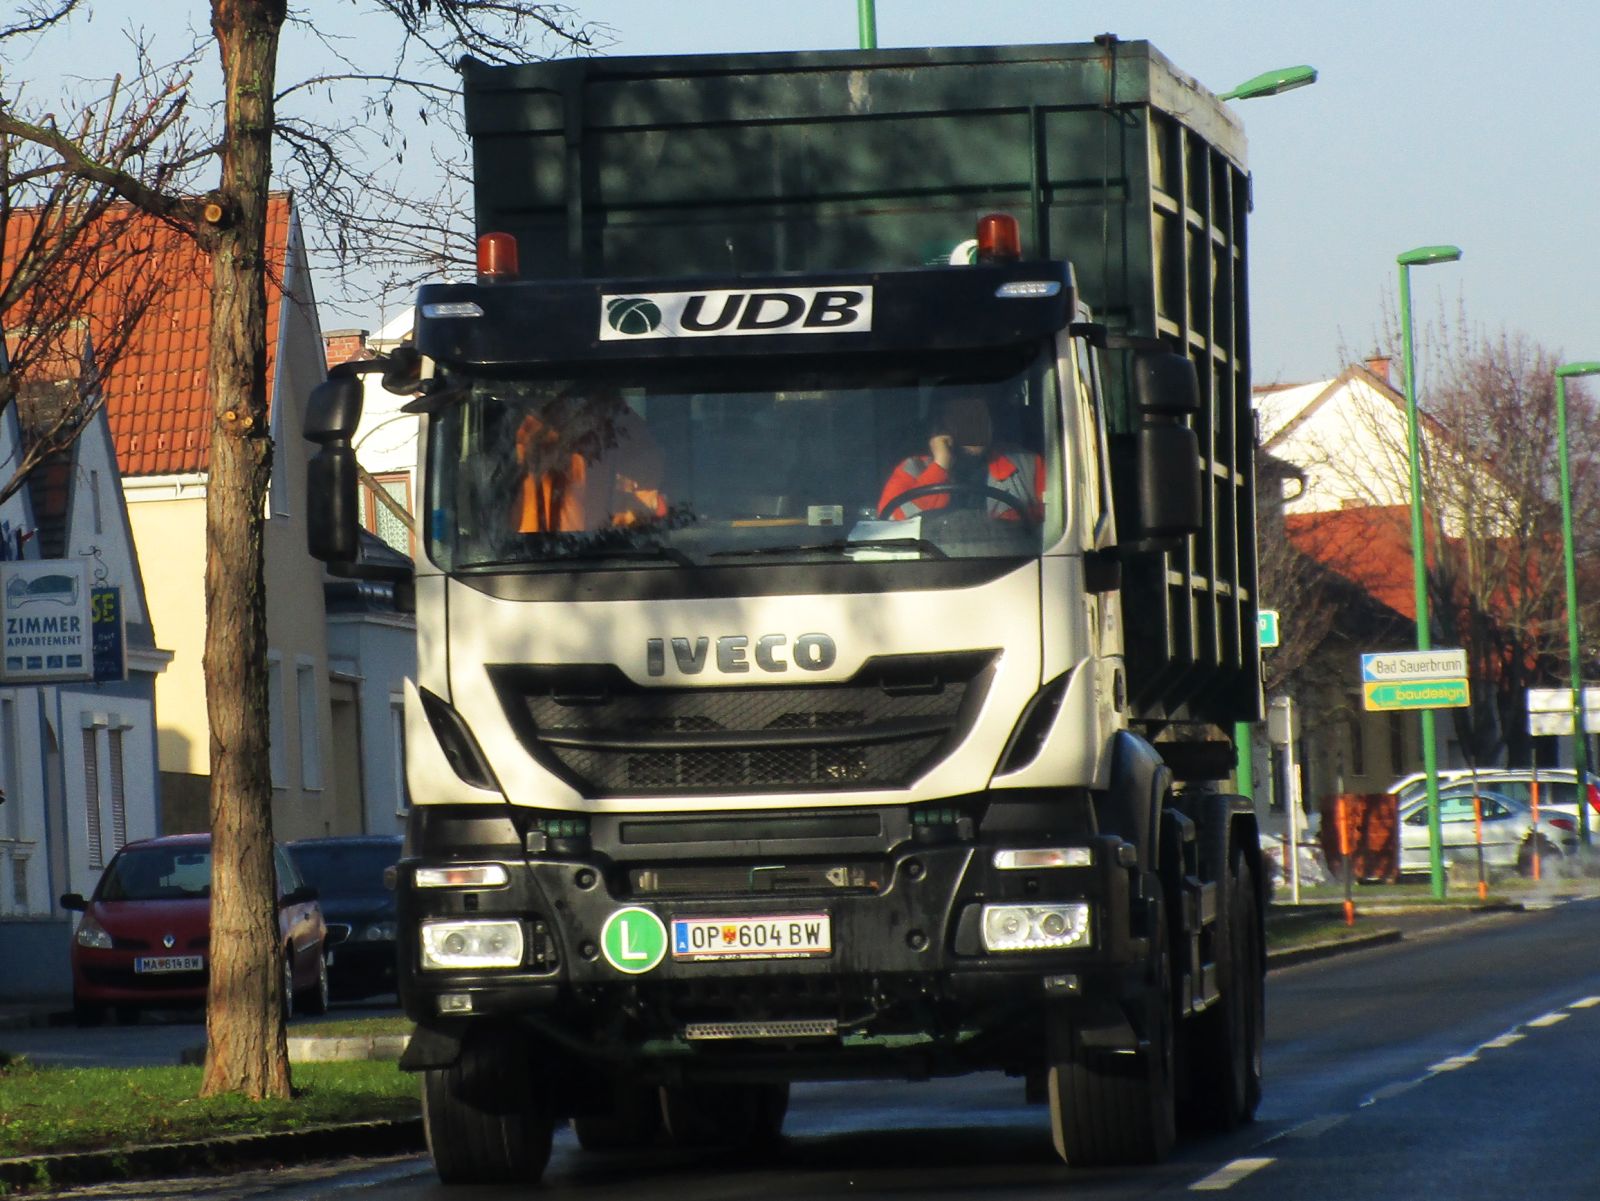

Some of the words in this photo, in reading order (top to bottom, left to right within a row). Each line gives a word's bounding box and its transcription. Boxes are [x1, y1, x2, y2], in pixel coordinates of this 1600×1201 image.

[680, 291, 863, 332] UDB
[7, 616, 80, 634] ZIMMER
[7, 635, 81, 647] APPARTEMENT
[647, 633, 836, 676] IVECO
[1376, 660, 1397, 674] Bad
[1400, 659, 1462, 673] Sauerbrunn
[619, 920, 647, 960] L
[739, 925, 782, 946] 604
[789, 923, 820, 945] BW
